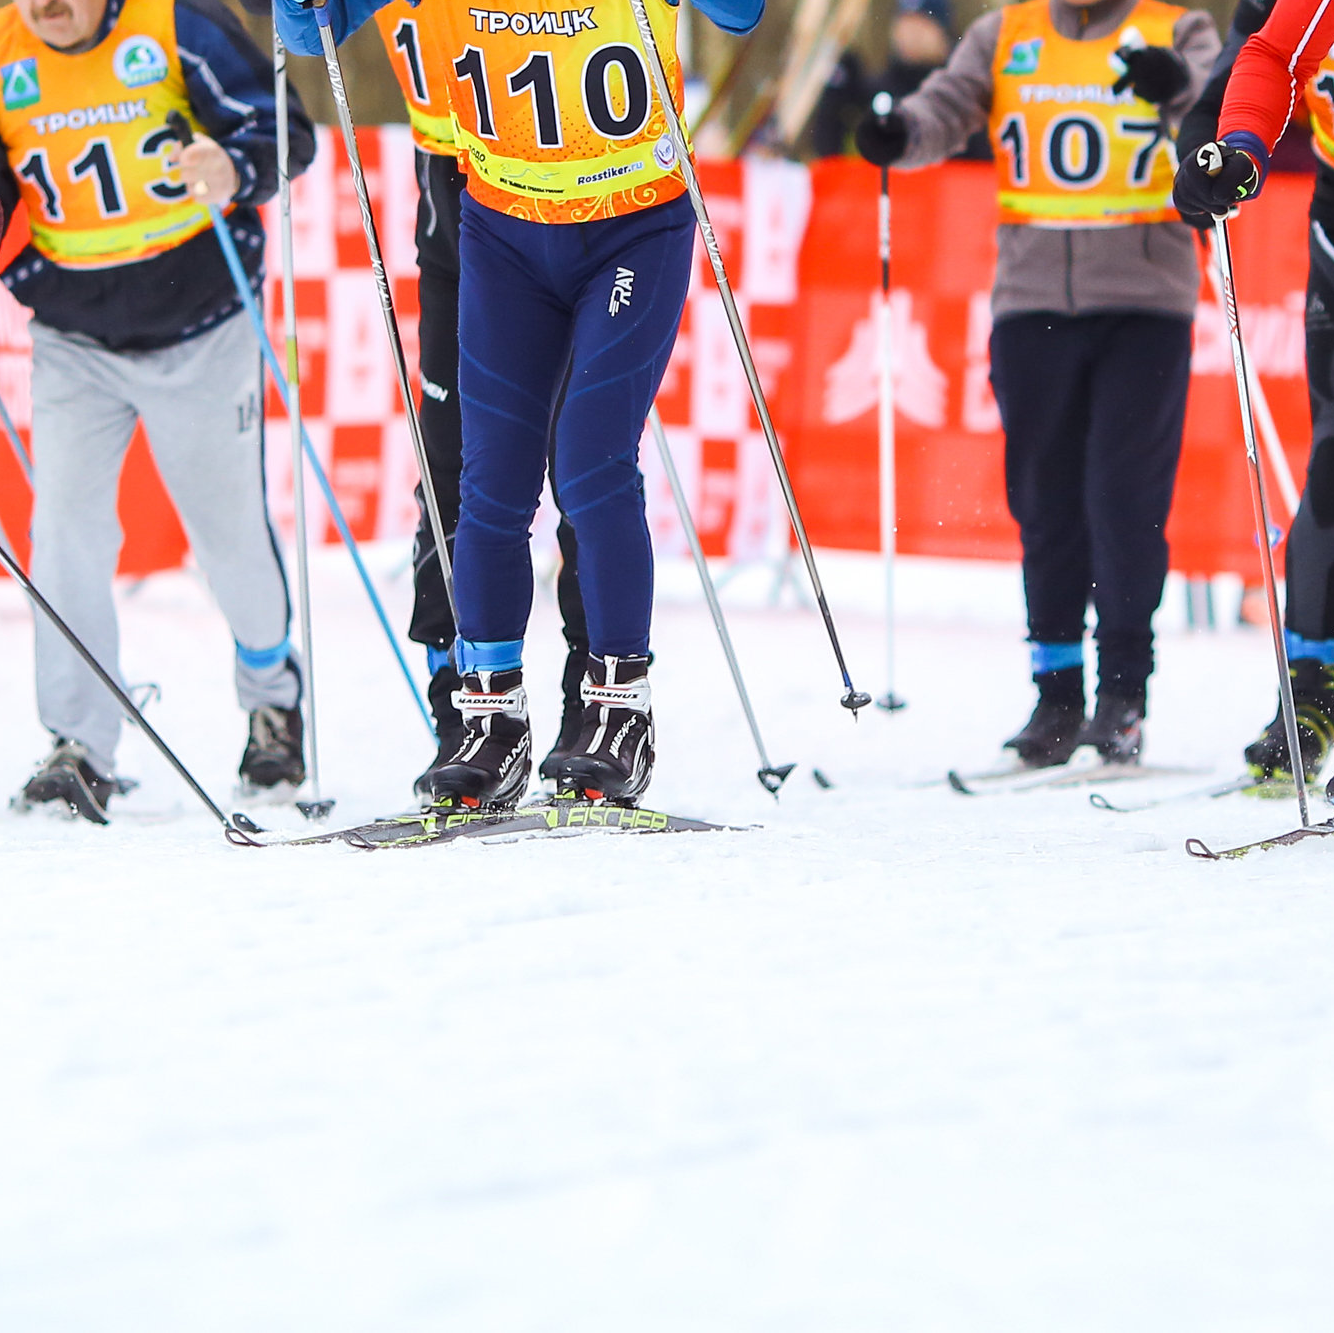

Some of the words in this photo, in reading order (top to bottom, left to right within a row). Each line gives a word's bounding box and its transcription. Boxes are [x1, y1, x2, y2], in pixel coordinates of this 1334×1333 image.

[468, 7, 598, 37] ТРОИЦК
[452, 42, 651, 150] 110
[29, 98, 151, 136] ТРОИЦК
[997, 111, 1161, 192] 107
[16, 125, 192, 224] 113
[577, 161, 644, 186] Rosstiker.ru
[458, 697, 516, 705] MADSHUS
[582, 689, 640, 699] MADSHUS
[567, 806, 668, 830] FISCHER
